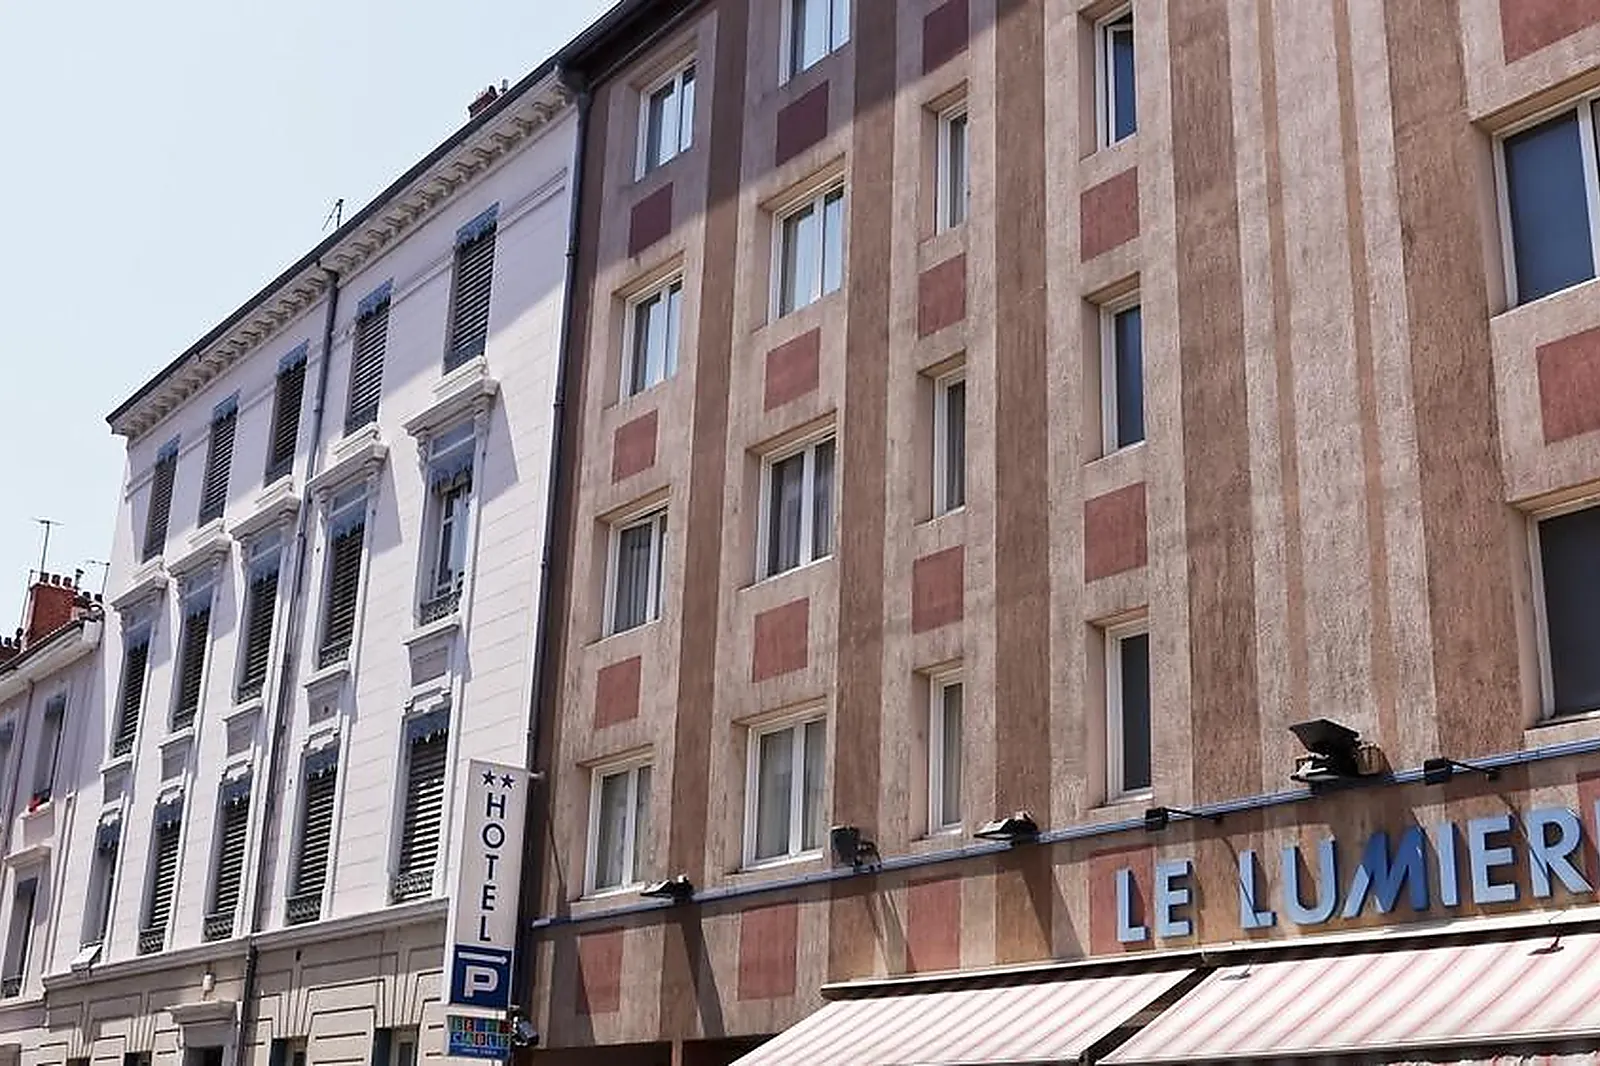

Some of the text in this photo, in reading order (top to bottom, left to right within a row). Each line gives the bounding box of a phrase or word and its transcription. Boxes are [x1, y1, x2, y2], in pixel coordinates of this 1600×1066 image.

[479, 792, 506, 942] HOTEL
[1116, 799, 1600, 942] LE LUMIER
[464, 964, 499, 998] P
